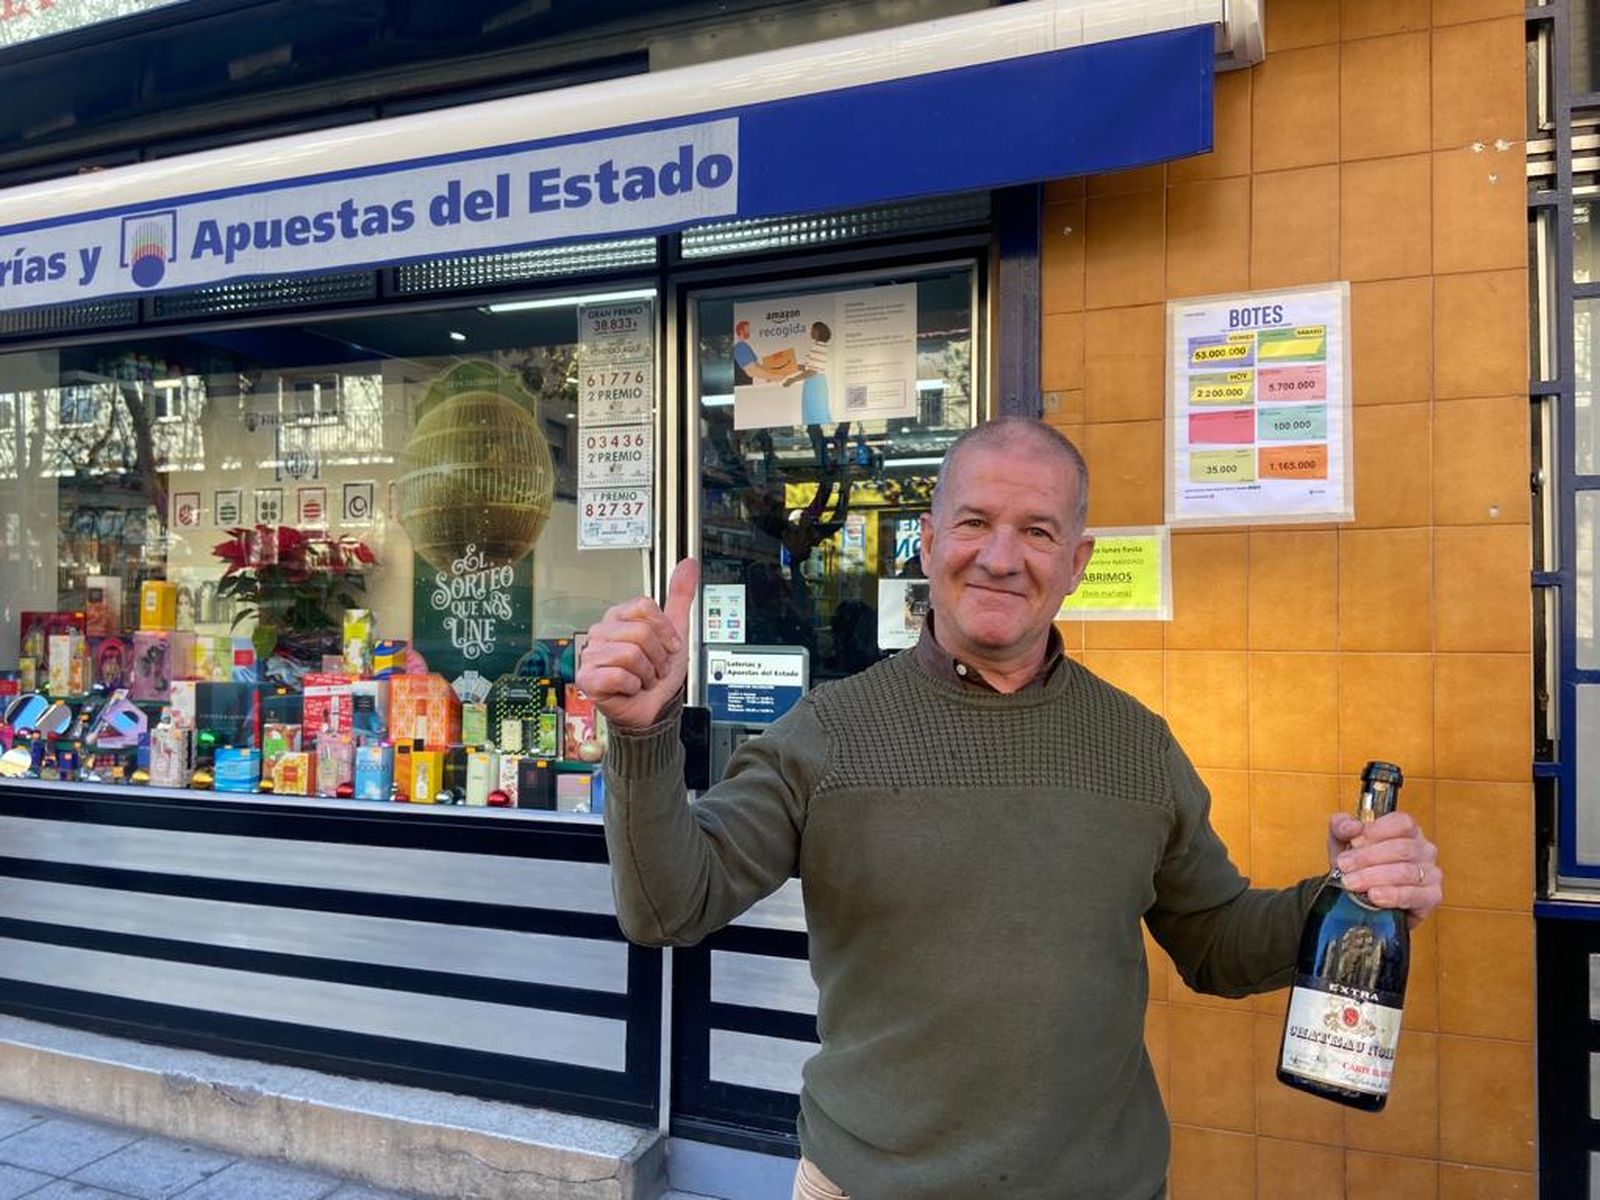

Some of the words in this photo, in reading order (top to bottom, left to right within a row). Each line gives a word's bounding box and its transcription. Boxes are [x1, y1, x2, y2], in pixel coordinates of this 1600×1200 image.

[79, 246, 103, 286] y
[190, 198, 416, 265] Apuestas
[428, 172, 511, 227] del
[528, 144, 734, 214] Estado
[588, 308, 611, 319] GRAN
[613, 306, 643, 317] PREMIO
[766, 309, 801, 321] amazon
[1229, 305, 1284, 328] BOTES
[759, 323, 807, 338] recogida
[586, 371, 644, 387] 61776
[597, 386, 643, 401] PREMIO
[586, 434, 644, 449] 03436
[597, 450, 642, 463] PREMIO
[601, 491, 638, 502] PREMIO
[585, 502, 644, 517] 82737
[430, 564, 515, 611] SORTEO
[450, 600, 479, 619] QUE
[482, 590, 513, 621] NOS
[443, 616, 498, 660] UNE
[727, 669, 760, 677] Apuestas
[1328, 982, 1380, 1002] EXTRA
[1289, 1024, 1366, 1055] CHATEAU
